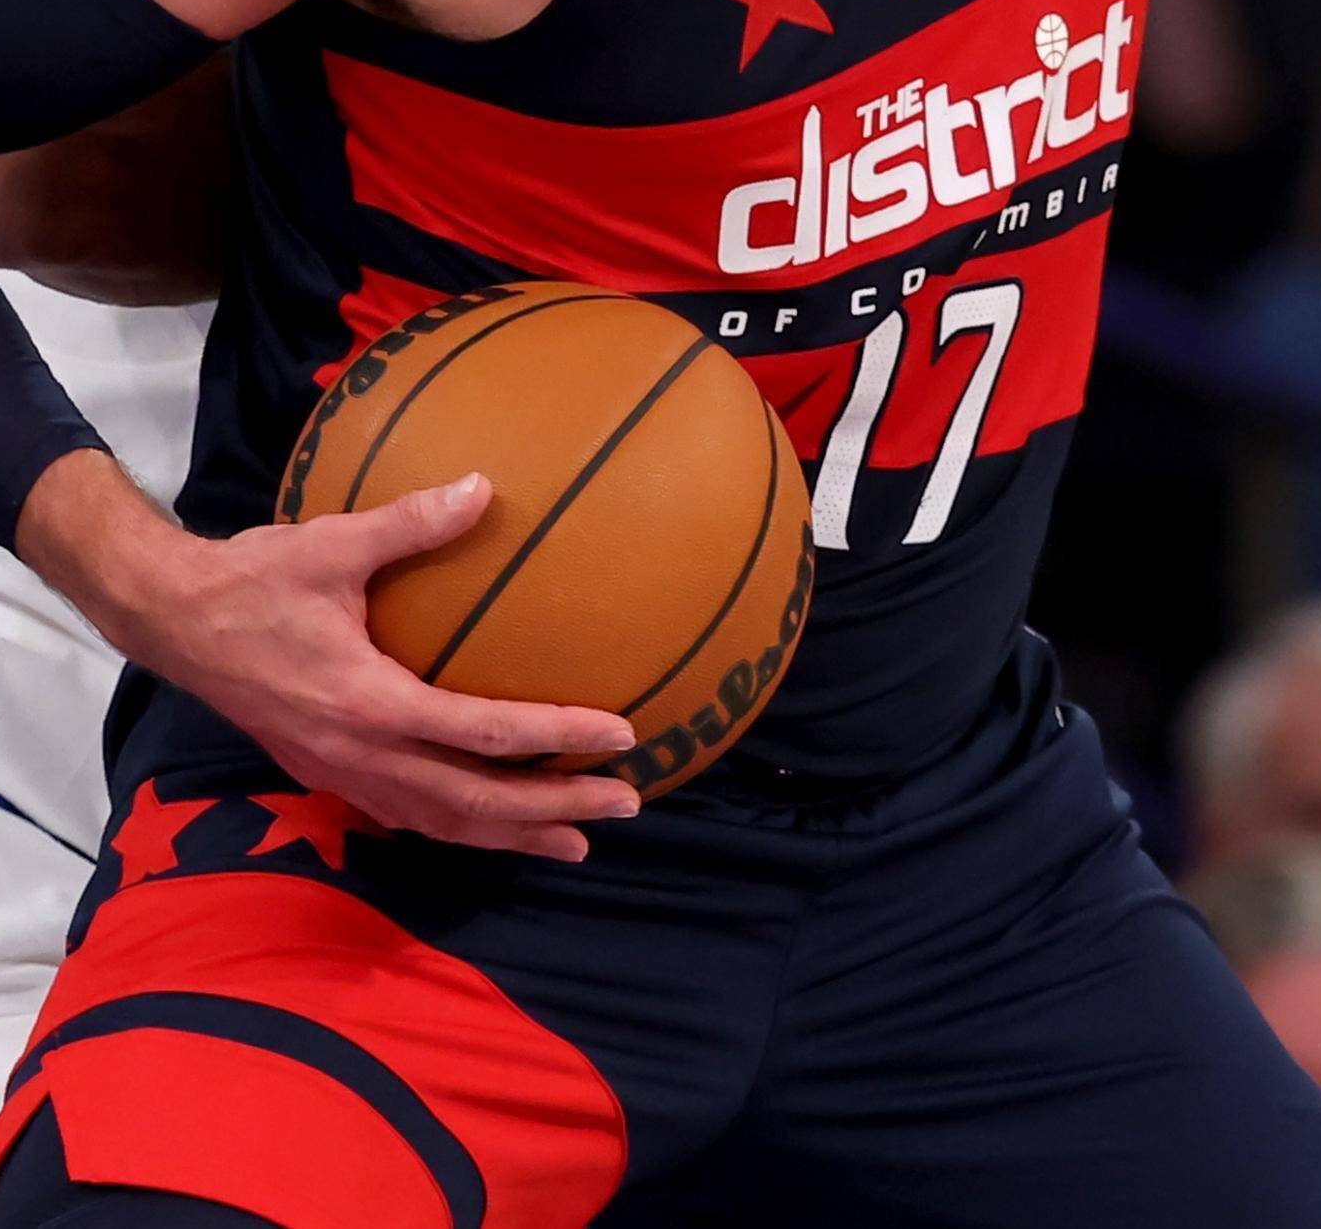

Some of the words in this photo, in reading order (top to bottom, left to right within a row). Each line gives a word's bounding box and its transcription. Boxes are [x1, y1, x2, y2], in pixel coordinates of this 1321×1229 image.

[856, 78, 923, 137] THE
[718, 308, 798, 337] OF
[812, 282, 1021, 551] 17
